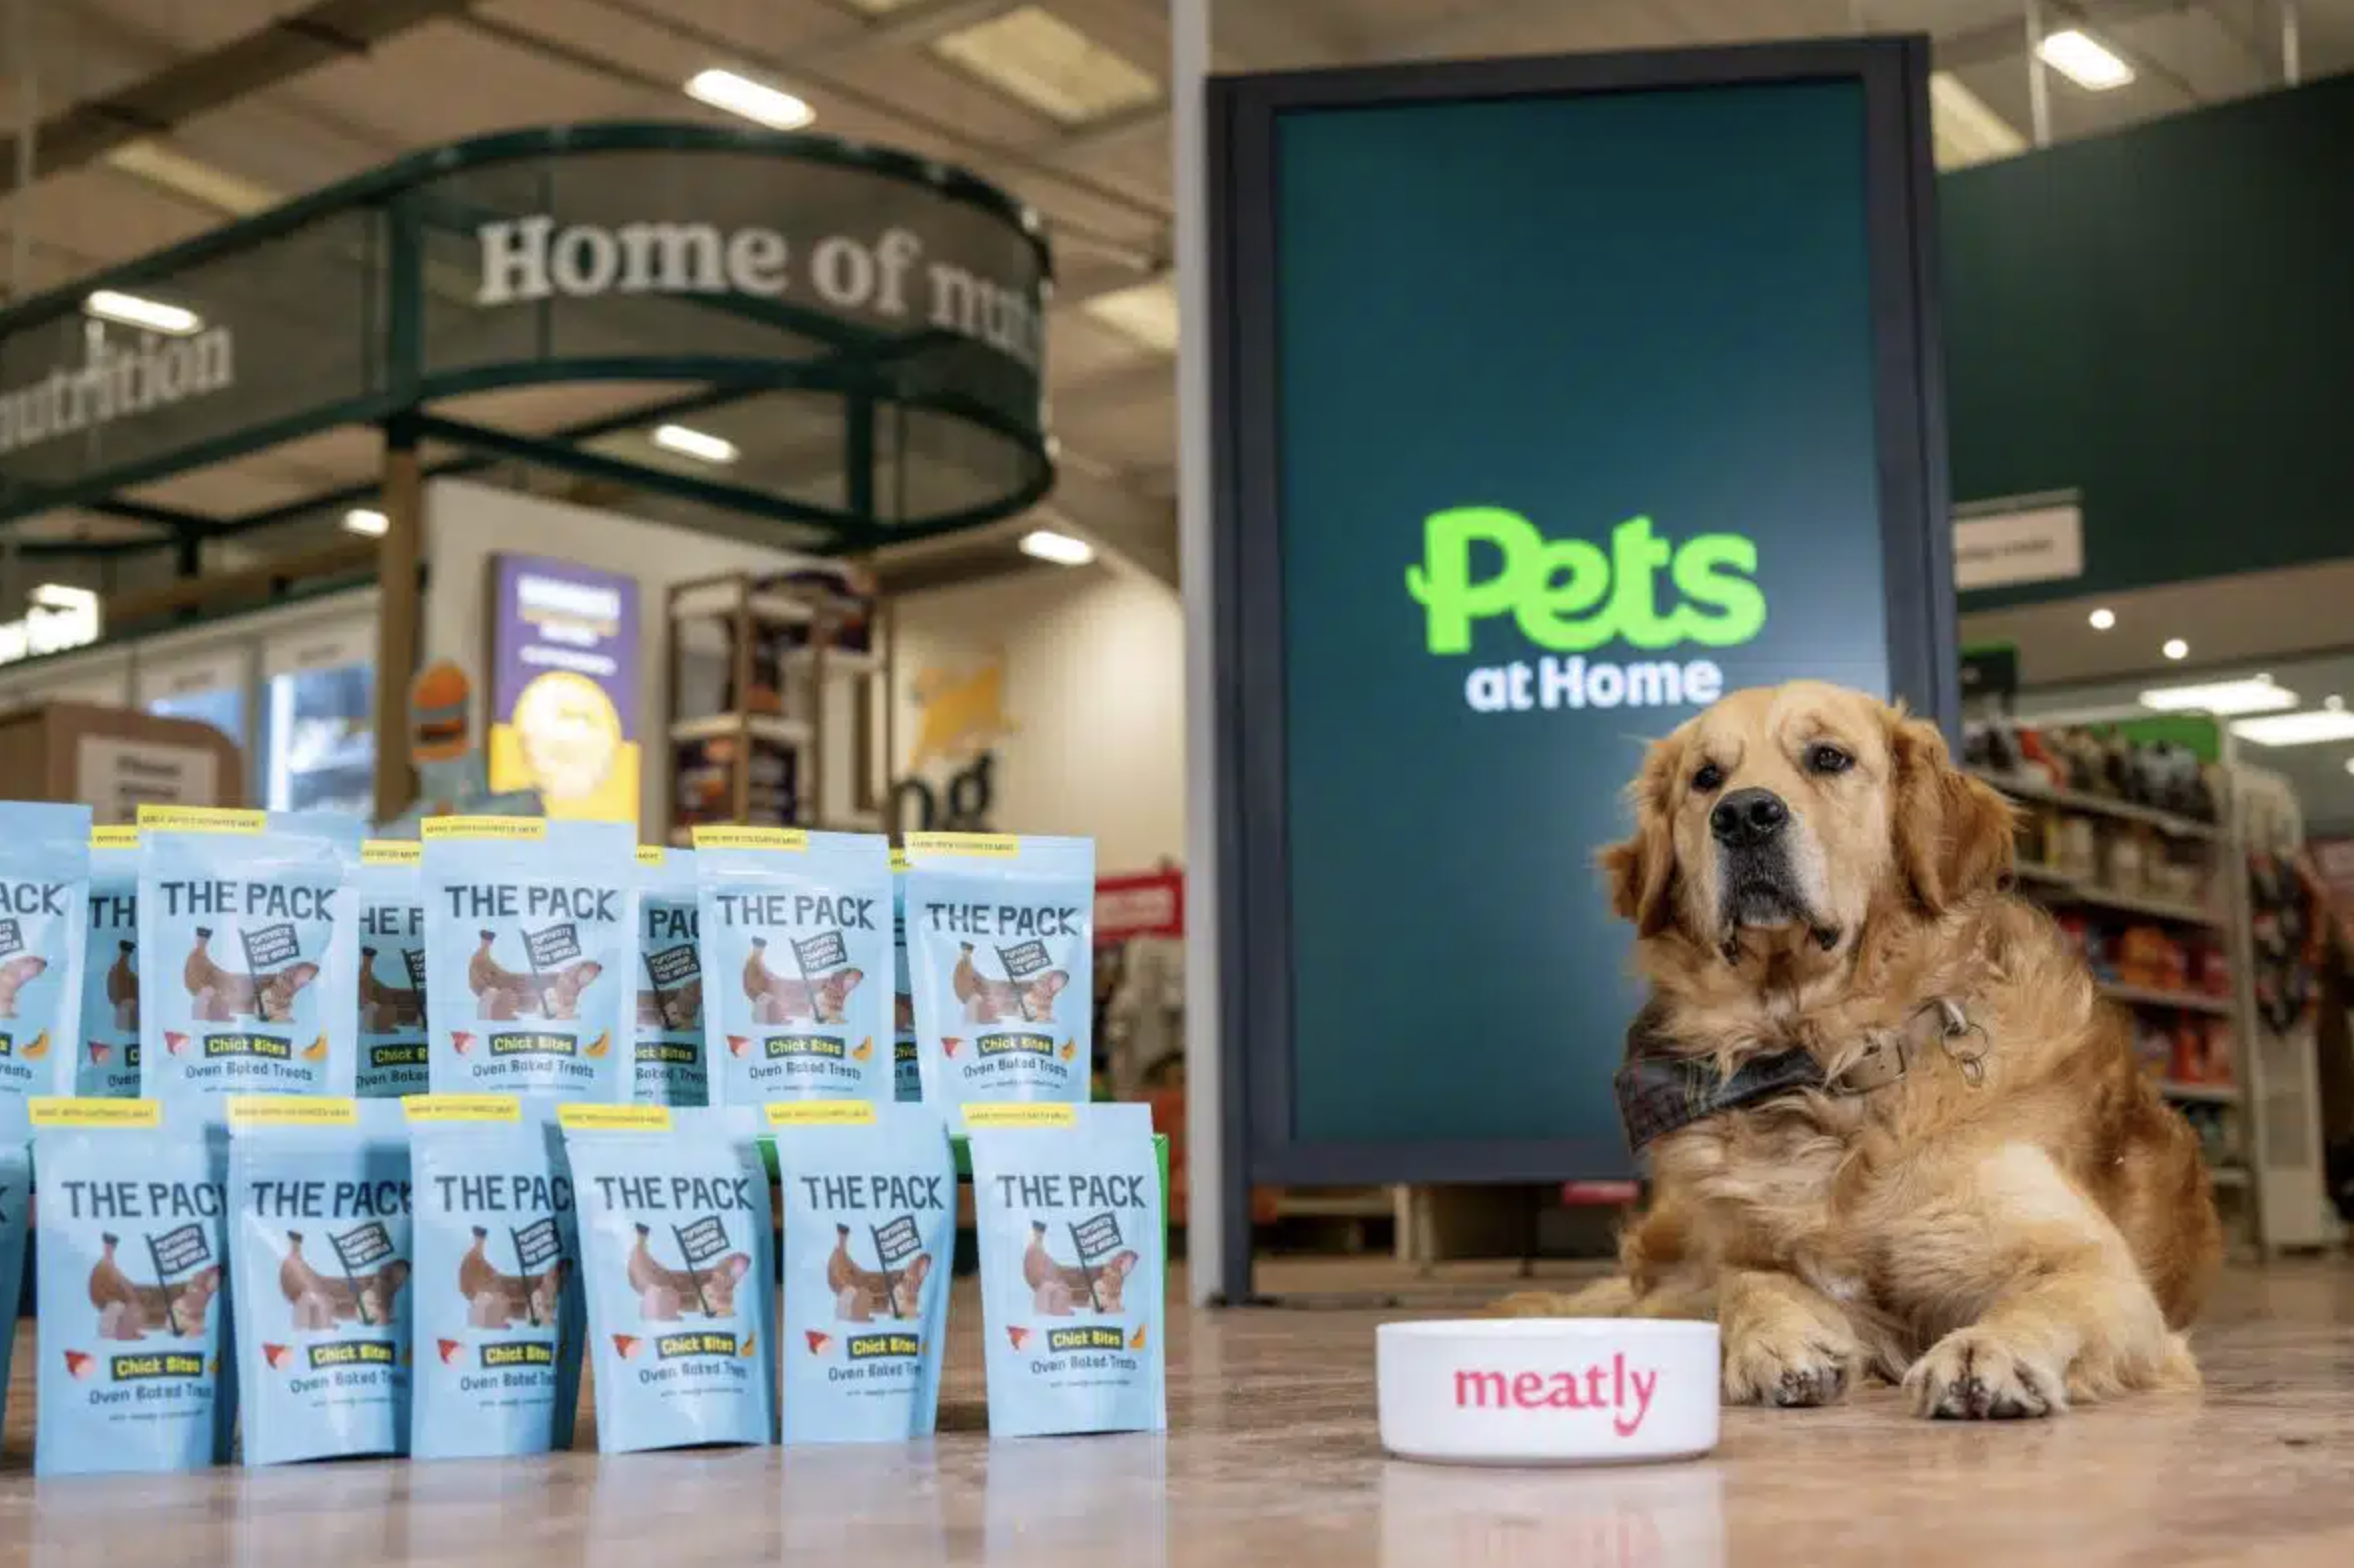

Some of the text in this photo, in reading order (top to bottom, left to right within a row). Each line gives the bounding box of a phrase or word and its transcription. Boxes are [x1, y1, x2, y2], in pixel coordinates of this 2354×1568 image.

[478, 214, 788, 301] Home
[811, 230, 922, 316] of
[1406, 507, 1766, 655] Pets
[1465, 655, 1723, 711] at Home
[160, 881, 336, 921] THE PACK
[444, 885, 618, 922] THE PACK
[717, 895, 876, 930] THE PACK
[926, 903, 990, 934] THE
[998, 906, 1079, 936] PACK
[209, 1038, 286, 1056] Chick Bites
[493, 1037, 572, 1052] Chick Bites
[770, 1042, 807, 1055] Chick
[981, 1037, 1015, 1051] Chick
[186, 1063, 221, 1078] Oven
[273, 1064, 312, 1081] Treats
[473, 1063, 505, 1078] Oven
[558, 1062, 594, 1078] Treats
[750, 1066, 782, 1080] Oven
[963, 1062, 995, 1078] Oven
[61, 1181, 141, 1218] THE
[252, 1181, 325, 1217] THE
[435, 1175, 576, 1212] THE PAC
[594, 1176, 754, 1210] THE PACK
[801, 1175, 943, 1210] THE PACK
[997, 1175, 1147, 1209] THE PACK
[661, 1339, 701, 1353] Chick
[853, 1341, 886, 1355] Chick
[1052, 1333, 1088, 1347] Chick
[315, 1346, 357, 1364] Chick
[485, 1347, 524, 1364] Chick
[116, 1358, 161, 1376] Chick
[829, 1366, 864, 1382] Oven
[1031, 1359, 1066, 1374] Oven
[461, 1376, 498, 1391] Oven
[639, 1368, 677, 1384] Oven
[290, 1378, 329, 1393] Oven
[1454, 1353, 1657, 1436] meatly
[89, 1389, 130, 1404] Oven
